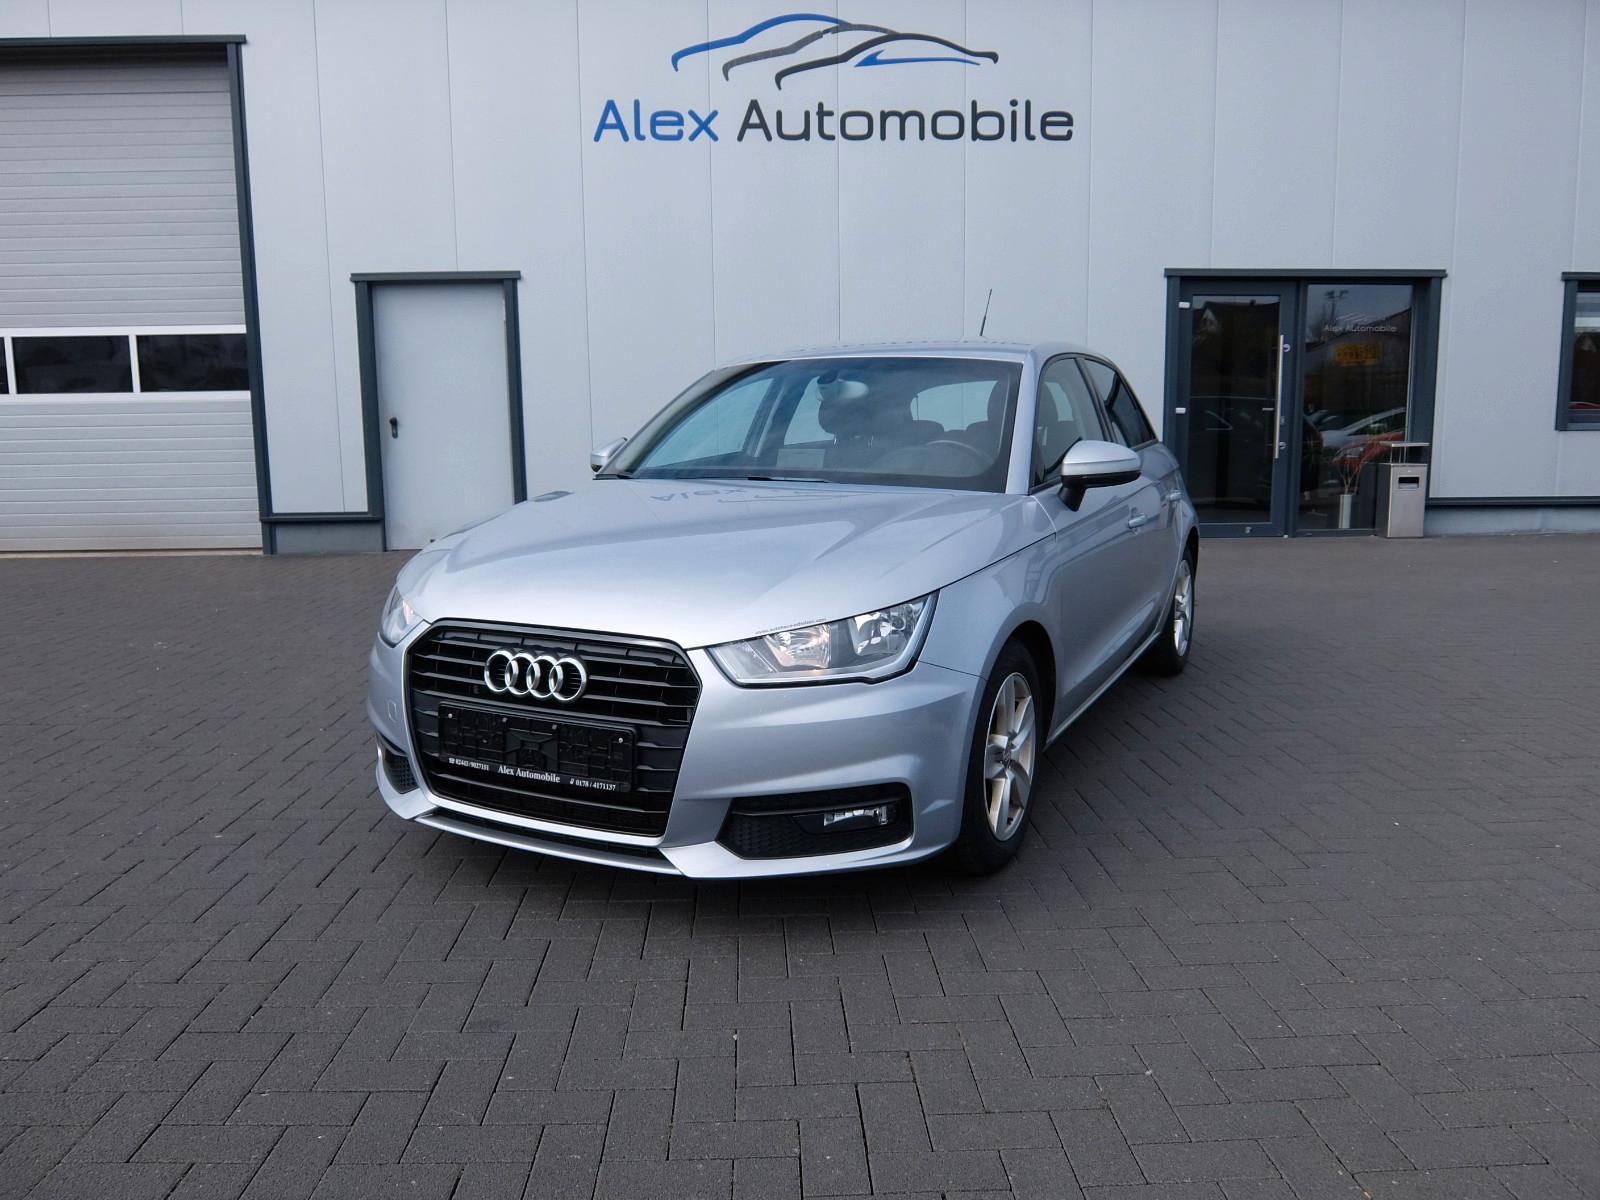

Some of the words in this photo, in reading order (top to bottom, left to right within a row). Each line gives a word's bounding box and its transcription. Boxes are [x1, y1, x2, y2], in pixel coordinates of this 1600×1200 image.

[593, 99, 719, 142] Alex
[737, 99, 1074, 142] Automobile
[1346, 323, 1397, 332] Automobile
[498, 765, 514, 776] Alex
[515, 767, 561, 784] Automobile
